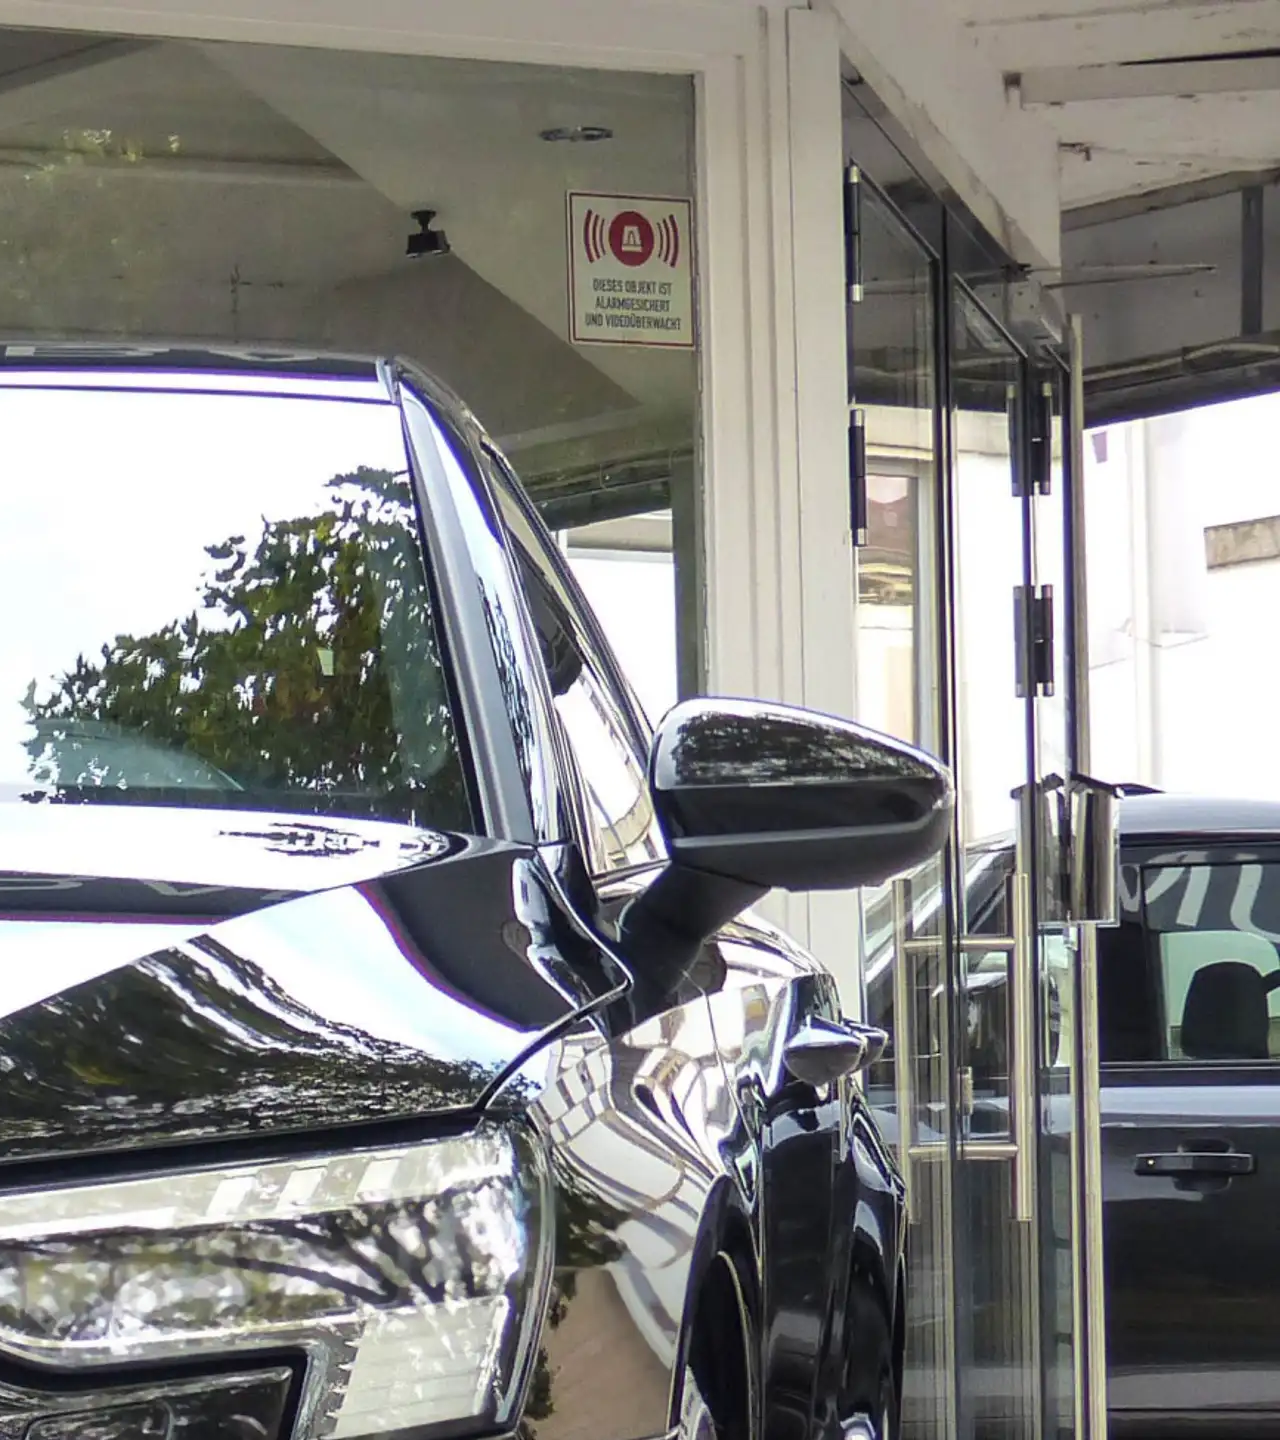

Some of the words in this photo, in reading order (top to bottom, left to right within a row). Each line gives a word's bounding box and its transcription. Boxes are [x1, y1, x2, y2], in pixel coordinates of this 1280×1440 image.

[593, 278, 623, 292] DIESES
[625, 280, 656, 295] OBJEKT
[658, 282, 672, 295] IST
[595, 296, 671, 312] ALARMGESICHERT
[585, 313, 603, 327] UND
[605, 313, 682, 330] VIDEOÜBERWACHT
